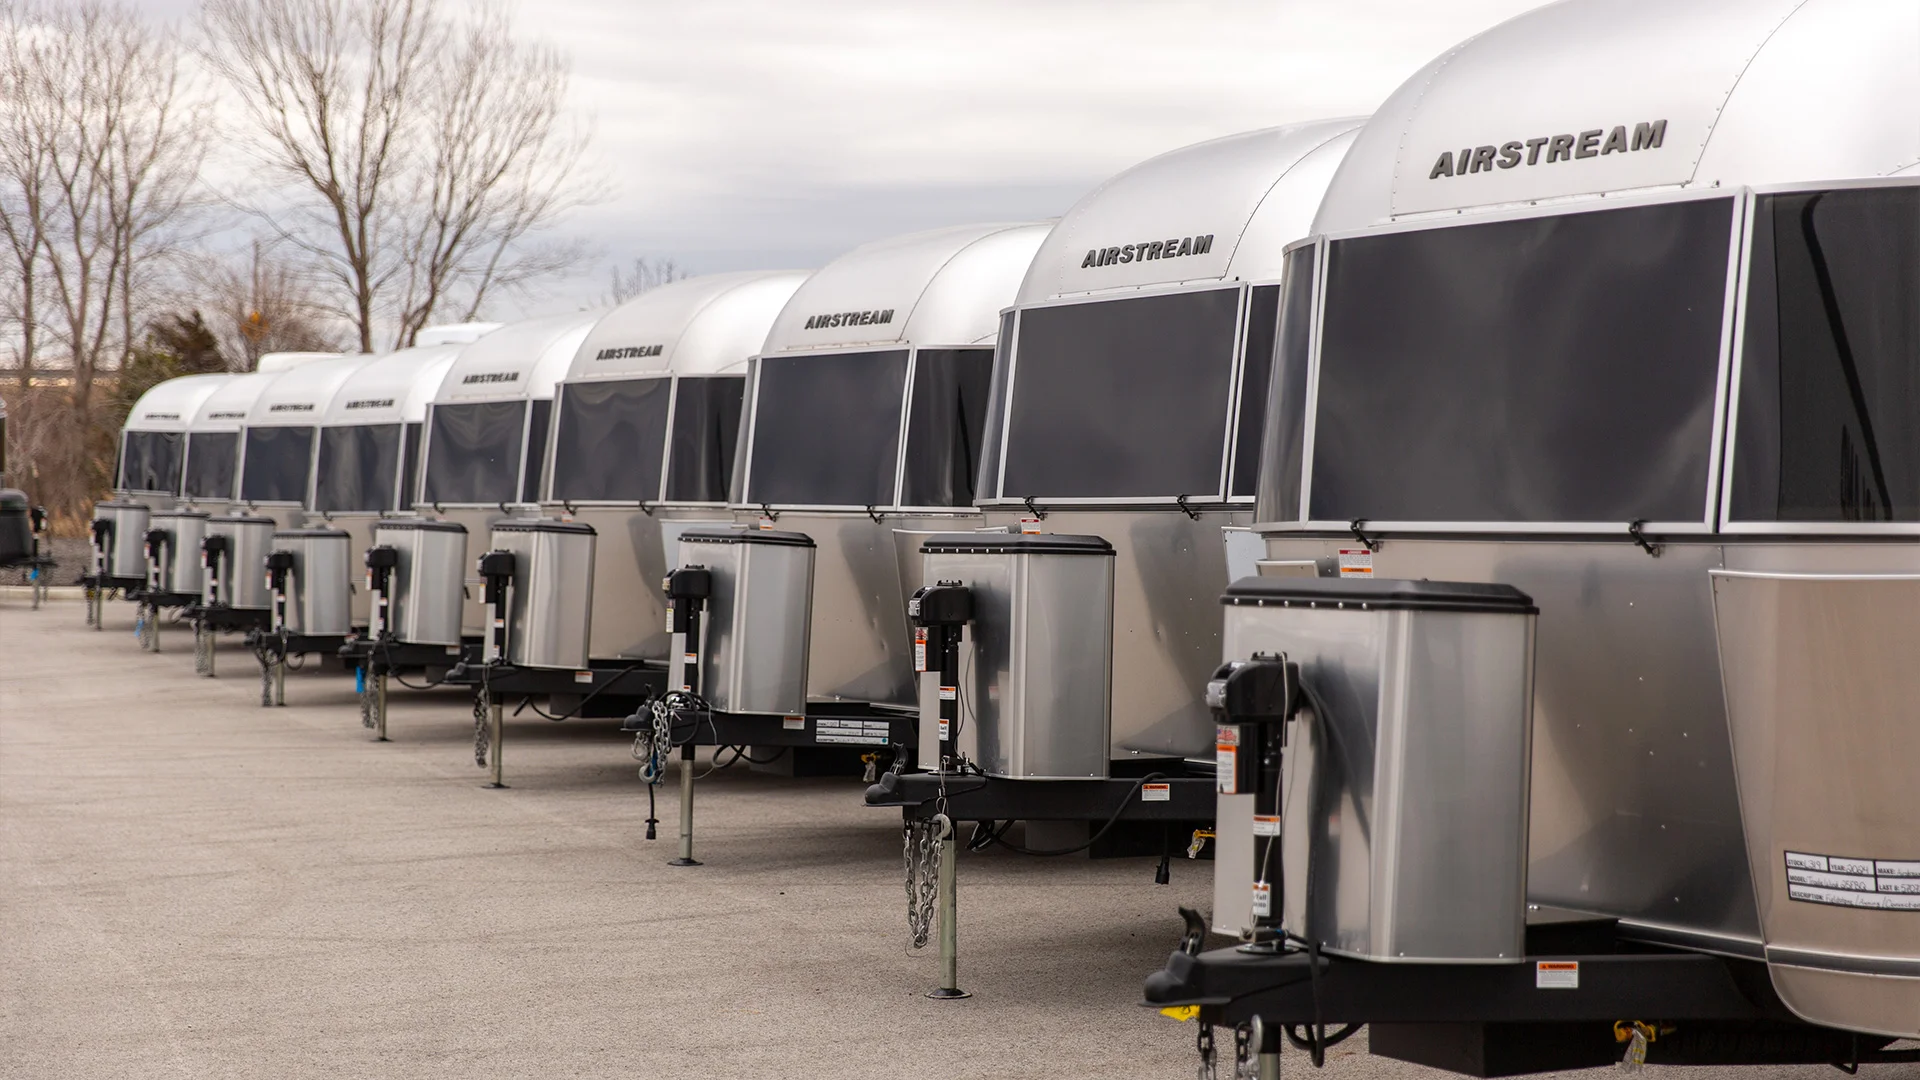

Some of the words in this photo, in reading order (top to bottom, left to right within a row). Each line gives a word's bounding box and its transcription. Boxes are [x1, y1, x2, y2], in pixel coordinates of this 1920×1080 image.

[1429, 119, 1668, 180] AIRSTREAM
[1081, 234, 1214, 269] AIRSTREAM
[804, 309, 895, 330] AIRSTREAM
[596, 344, 663, 361] AIRSTREAM
[462, 372, 520, 385] AIRSTREAM
